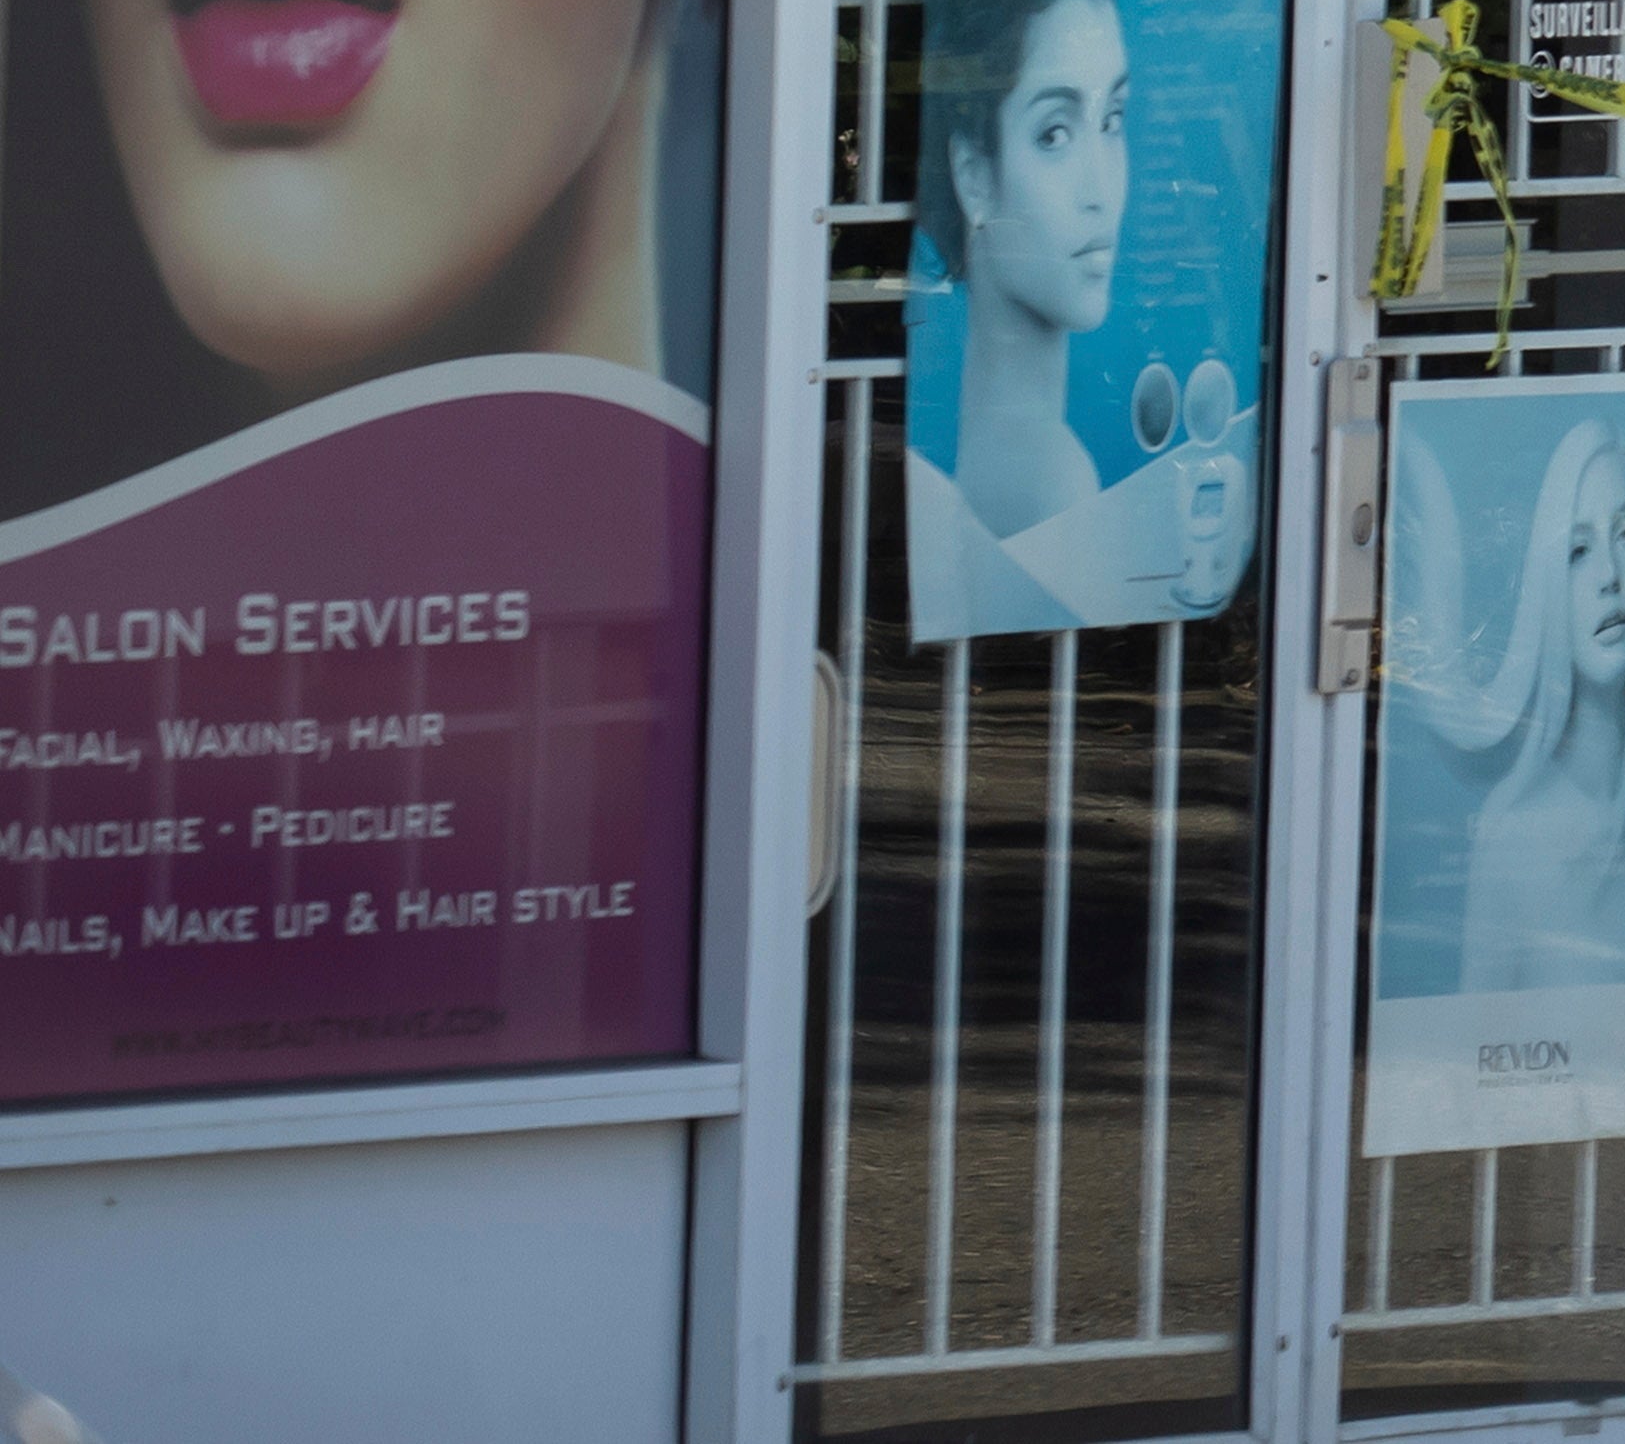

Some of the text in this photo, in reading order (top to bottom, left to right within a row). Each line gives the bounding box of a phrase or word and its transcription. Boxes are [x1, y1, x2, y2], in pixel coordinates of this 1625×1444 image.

[0, 589, 532, 668] SALON SERVICES
[158, 717, 334, 763] WAXING,
[347, 711, 446, 752] HAIR
[250, 800, 456, 849] PEDICURE
[141, 903, 259, 948] MAKE
[273, 900, 330, 940] UP
[344, 891, 378, 935] &
[398, 887, 497, 931] HAIR
[512, 879, 637, 924] STYLE
